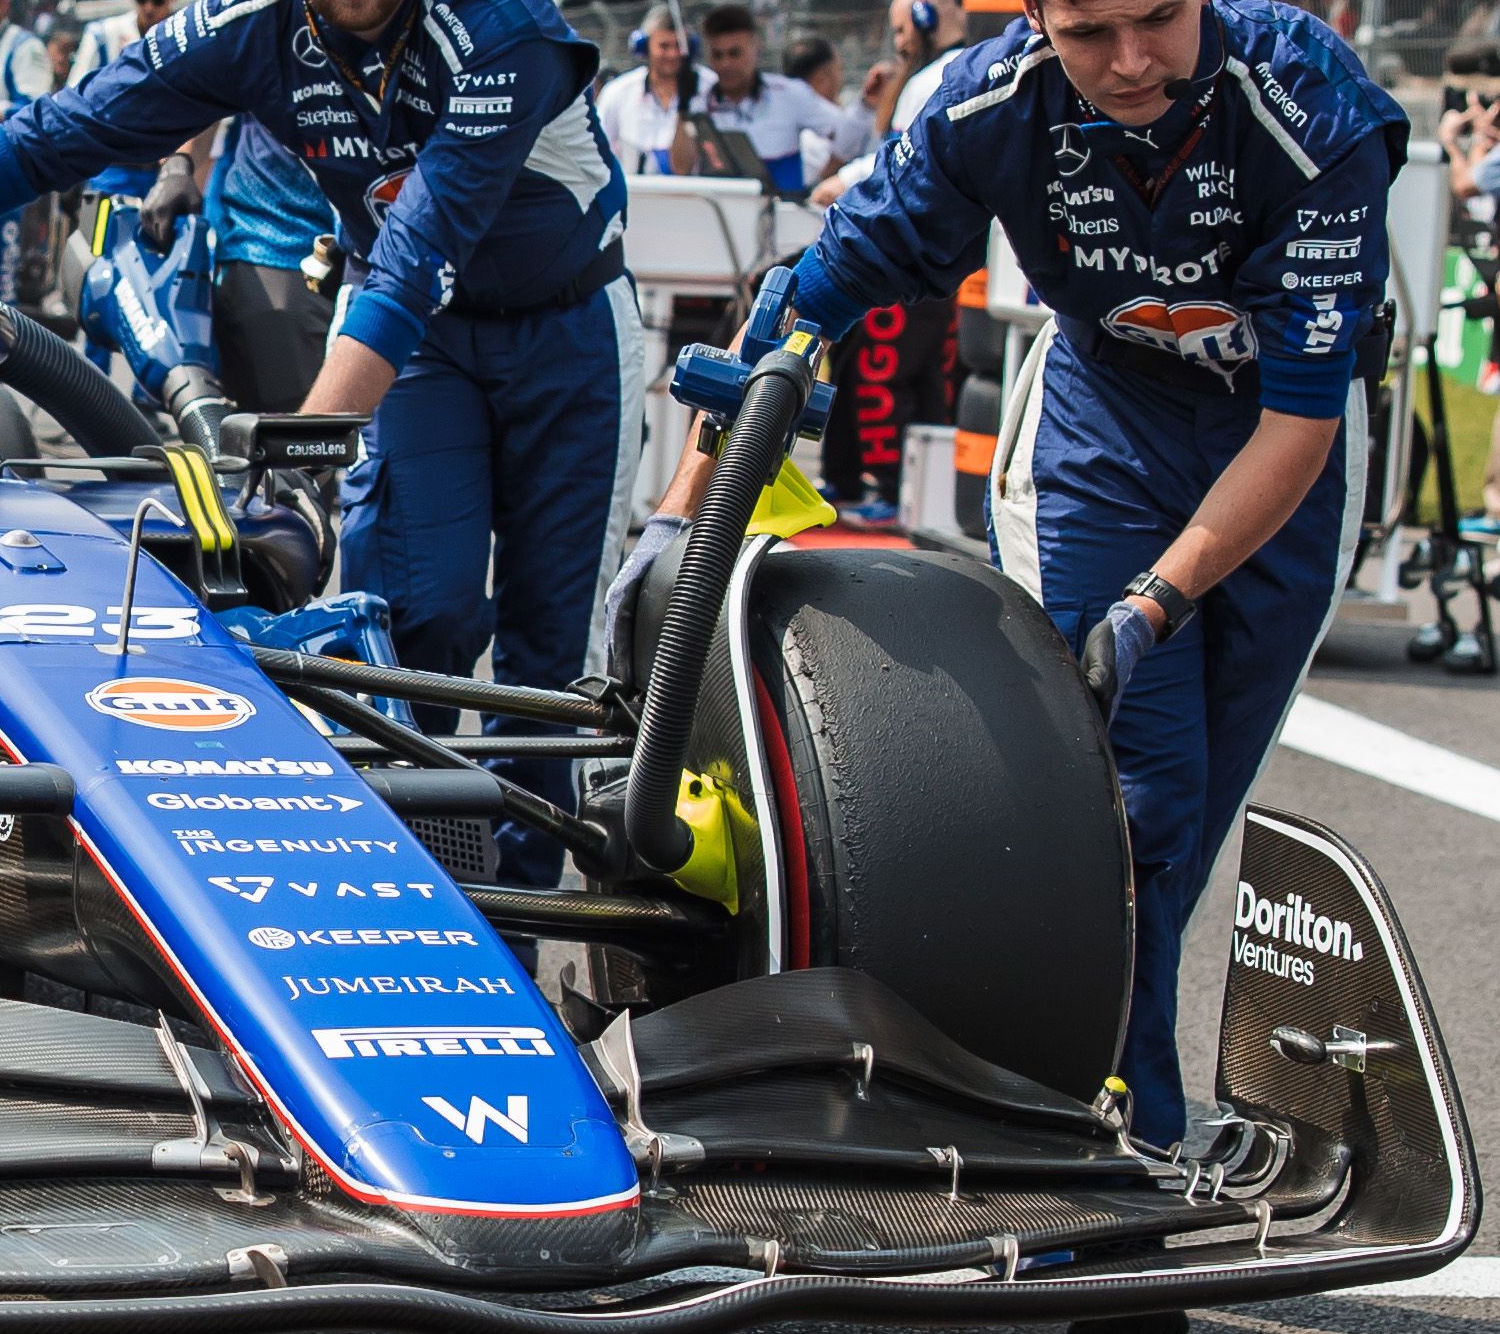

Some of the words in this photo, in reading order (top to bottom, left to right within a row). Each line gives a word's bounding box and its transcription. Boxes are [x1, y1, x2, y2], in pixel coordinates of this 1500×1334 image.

[472, 72, 518, 86] VAST
[449, 96, 514, 114] PIRELLI
[296, 105, 359, 127] Stephens
[1321, 205, 1369, 226] VAST
[1300, 271, 1363, 288] KEEPER
[856, 303, 906, 465] HUGO
[99, 695, 242, 712] Gulf
[115, 757, 335, 776] KOMATSU
[146, 793, 334, 812] Globant
[287, 881, 436, 899] VAST
[296, 929, 480, 946] KEEPER
[1233, 930, 1315, 986] Ventures
[281, 975, 517, 1001] JUMEIRAH
[311, 1026, 556, 1059] PIRELLI
[420, 1095, 529, 1145] W
